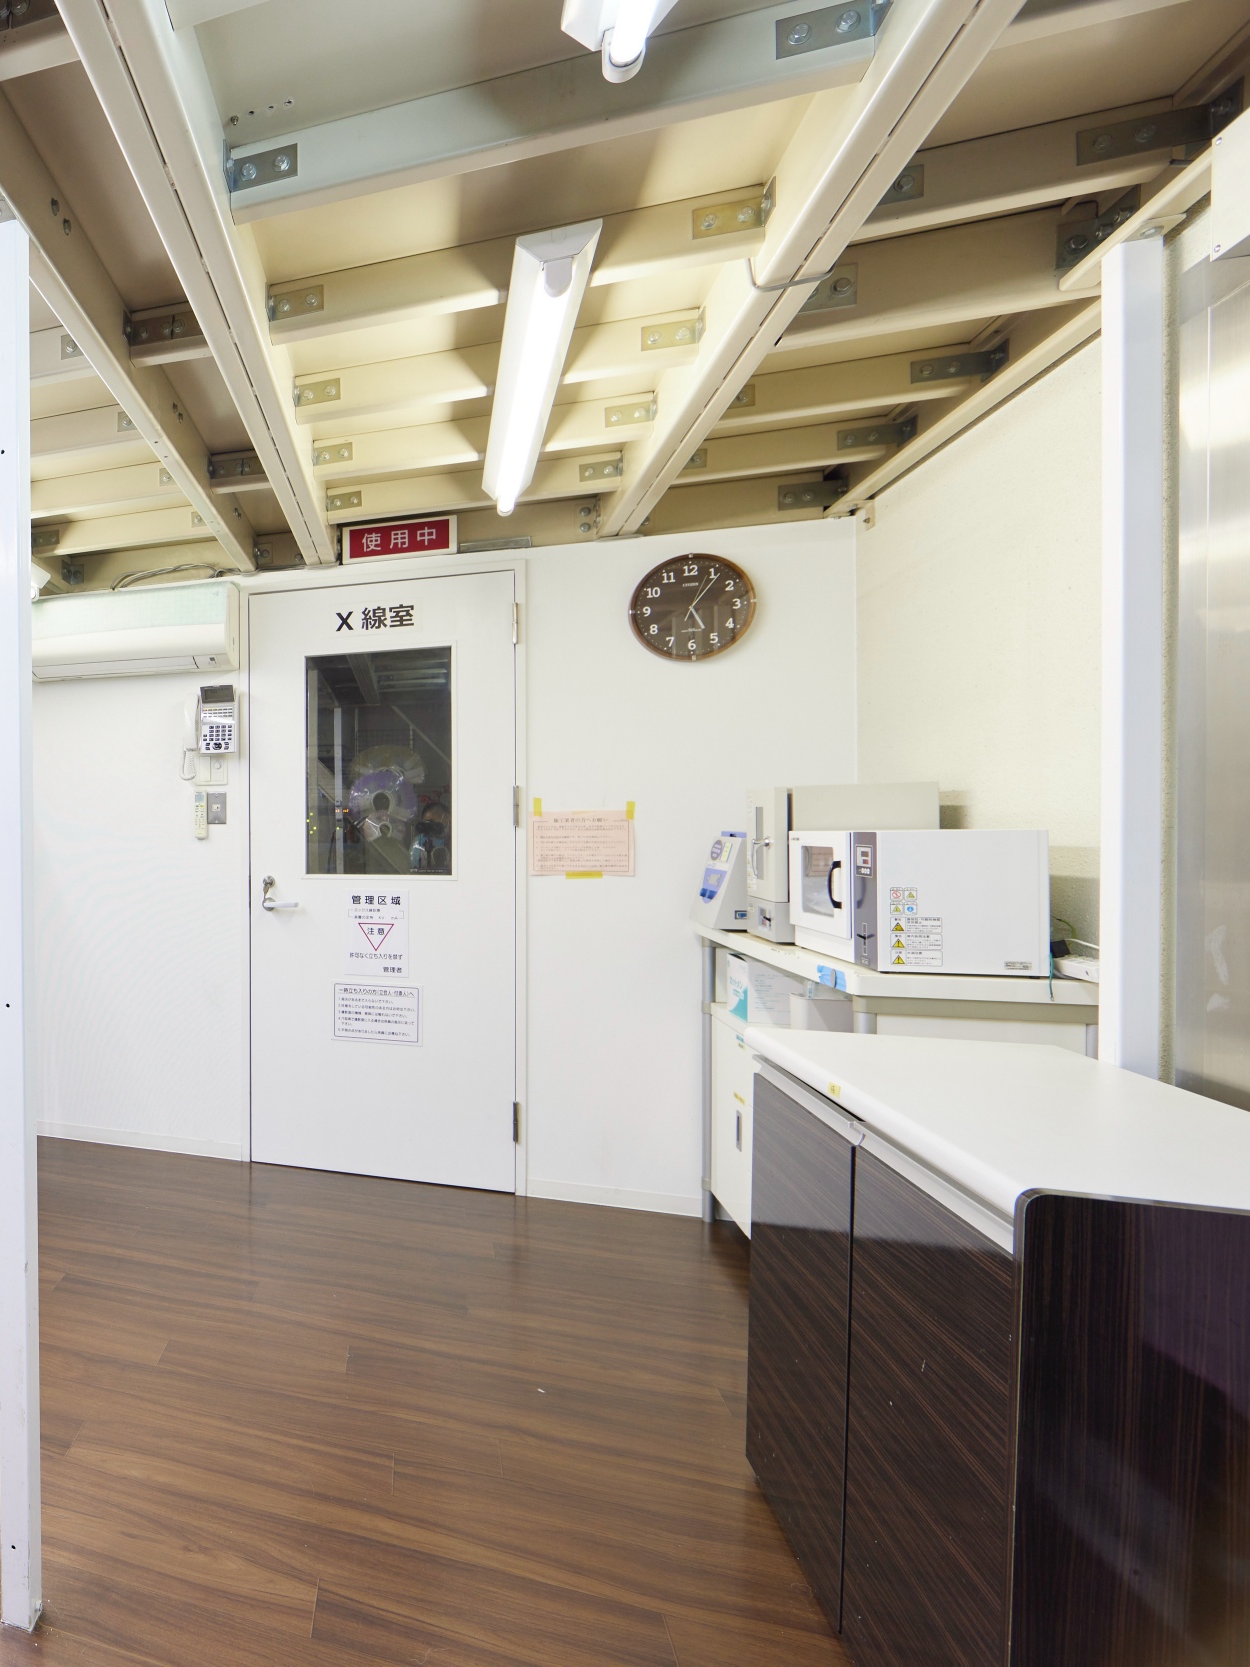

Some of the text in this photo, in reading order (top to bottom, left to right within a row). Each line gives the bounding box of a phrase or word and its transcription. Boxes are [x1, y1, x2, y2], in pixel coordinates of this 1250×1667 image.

[361, 527, 437, 552] 使用中
[683, 565, 698, 576] 12
[709, 568, 717, 579] 1
[662, 572, 676, 583] 11
[725, 580, 734, 591] 2
[646, 587, 661, 598] 10
[732, 598, 741, 609] 3
[642, 606, 651, 617] 9
[725, 618, 734, 628] 4
[650, 624, 658, 635] 8
[665, 636, 675, 647] 7
[710, 632, 718, 643] 5
[687, 640, 696, 650] 6
[351, 895, 401, 905] 管理区域
[367, 927, 385, 936] 注意
[349, 952, 403, 960] 許可なく立ち入りを禁ず
[383, 966, 403, 974] 管理者
